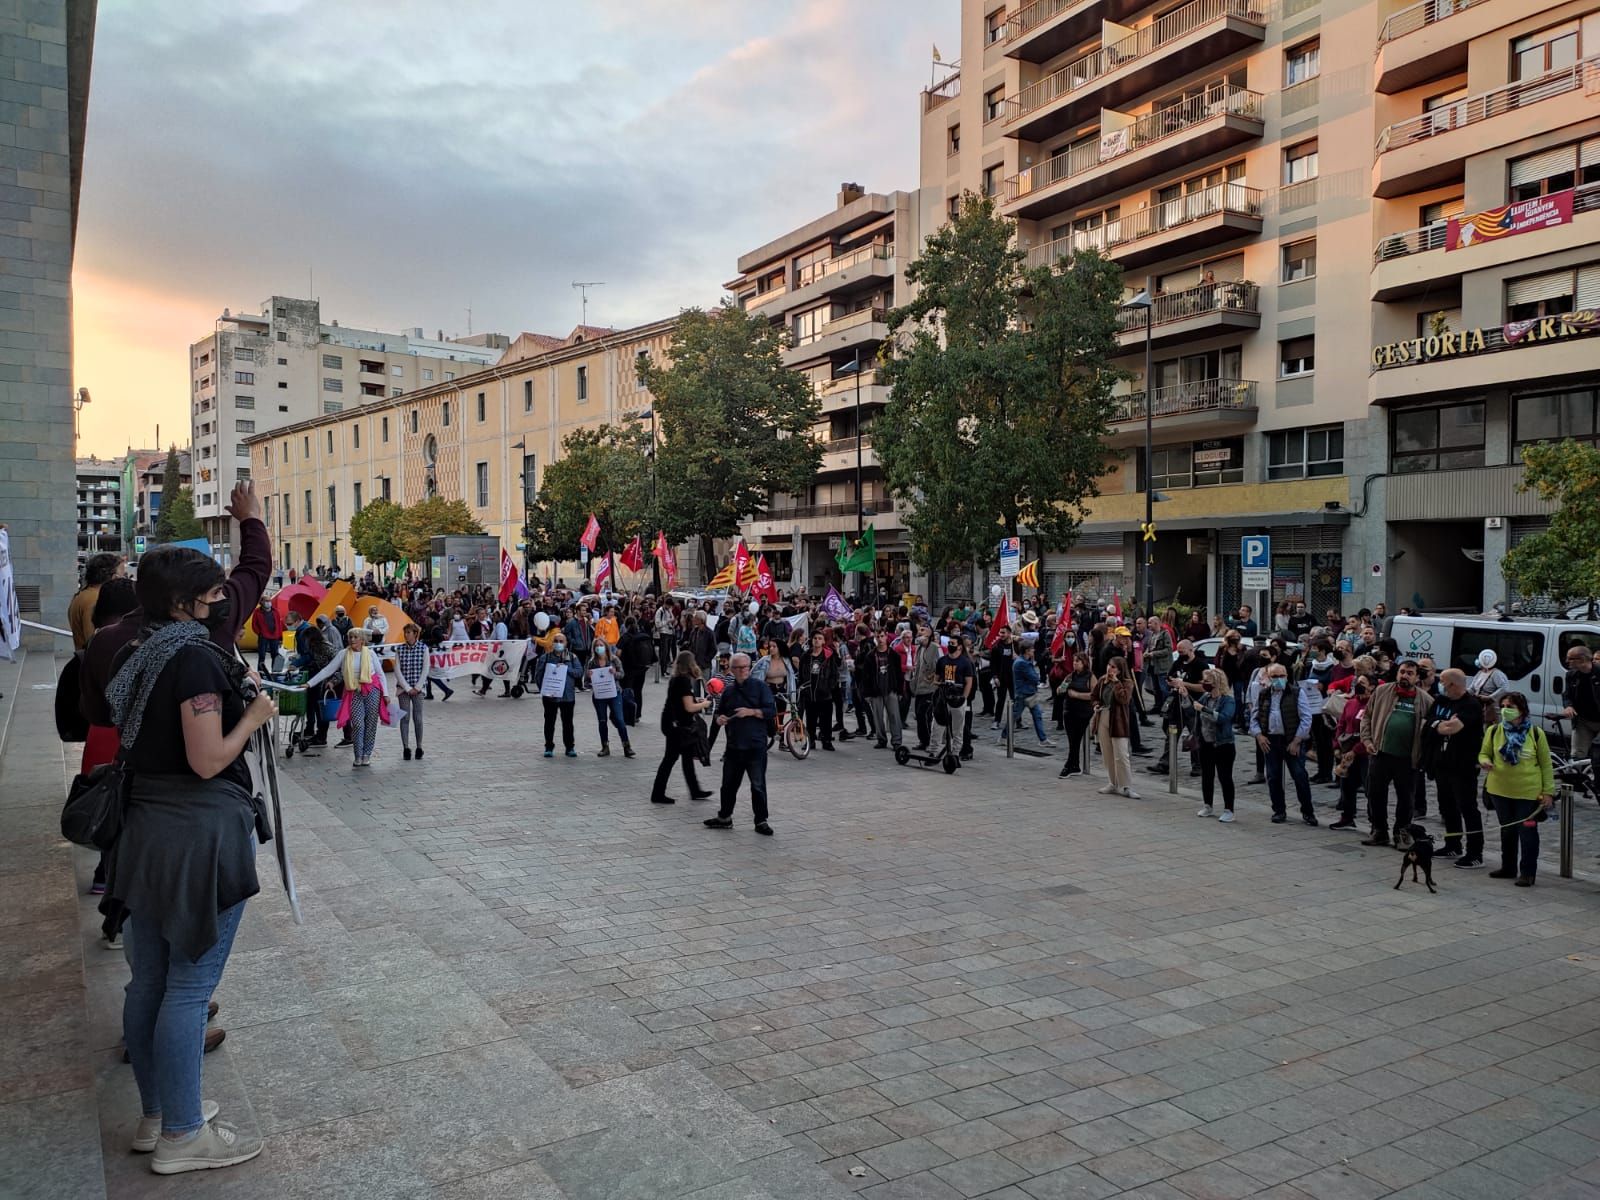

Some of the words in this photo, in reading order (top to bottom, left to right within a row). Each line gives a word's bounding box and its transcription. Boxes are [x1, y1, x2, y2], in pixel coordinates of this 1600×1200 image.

[1371, 327, 1486, 366] GESTORIA
[1002, 541, 1007, 550] P
[1247, 540, 1264, 565] P
[429, 652, 487, 669] IVILEGI
